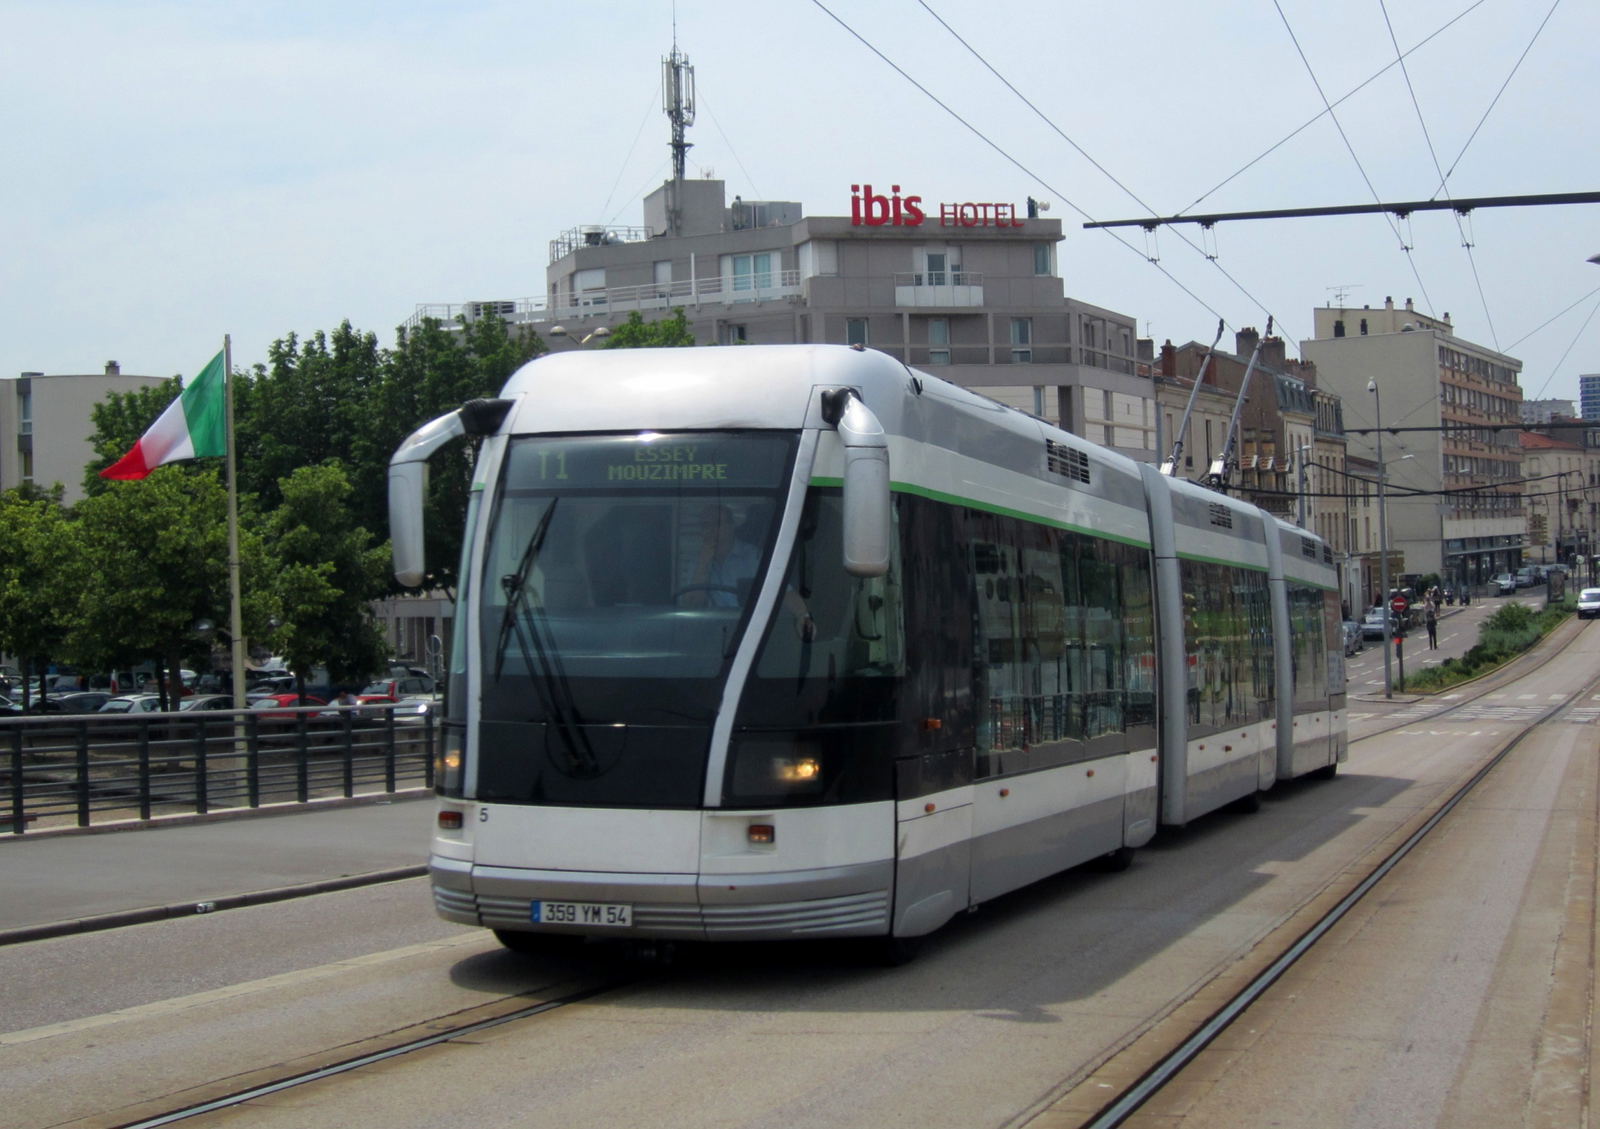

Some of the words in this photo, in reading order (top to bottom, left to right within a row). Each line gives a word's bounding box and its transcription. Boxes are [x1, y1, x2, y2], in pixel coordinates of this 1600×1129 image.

[851, 184, 925, 227] ibis
[939, 202, 1024, 228] HOTEL
[634, 447, 698, 462] ESSEY
[538, 451, 569, 480] T1
[608, 464, 728, 481] MOUZIMPRE
[479, 808, 489, 822] 5
[546, 904, 576, 922] 359
[582, 905, 601, 922] YM
[607, 907, 626, 924] 54
